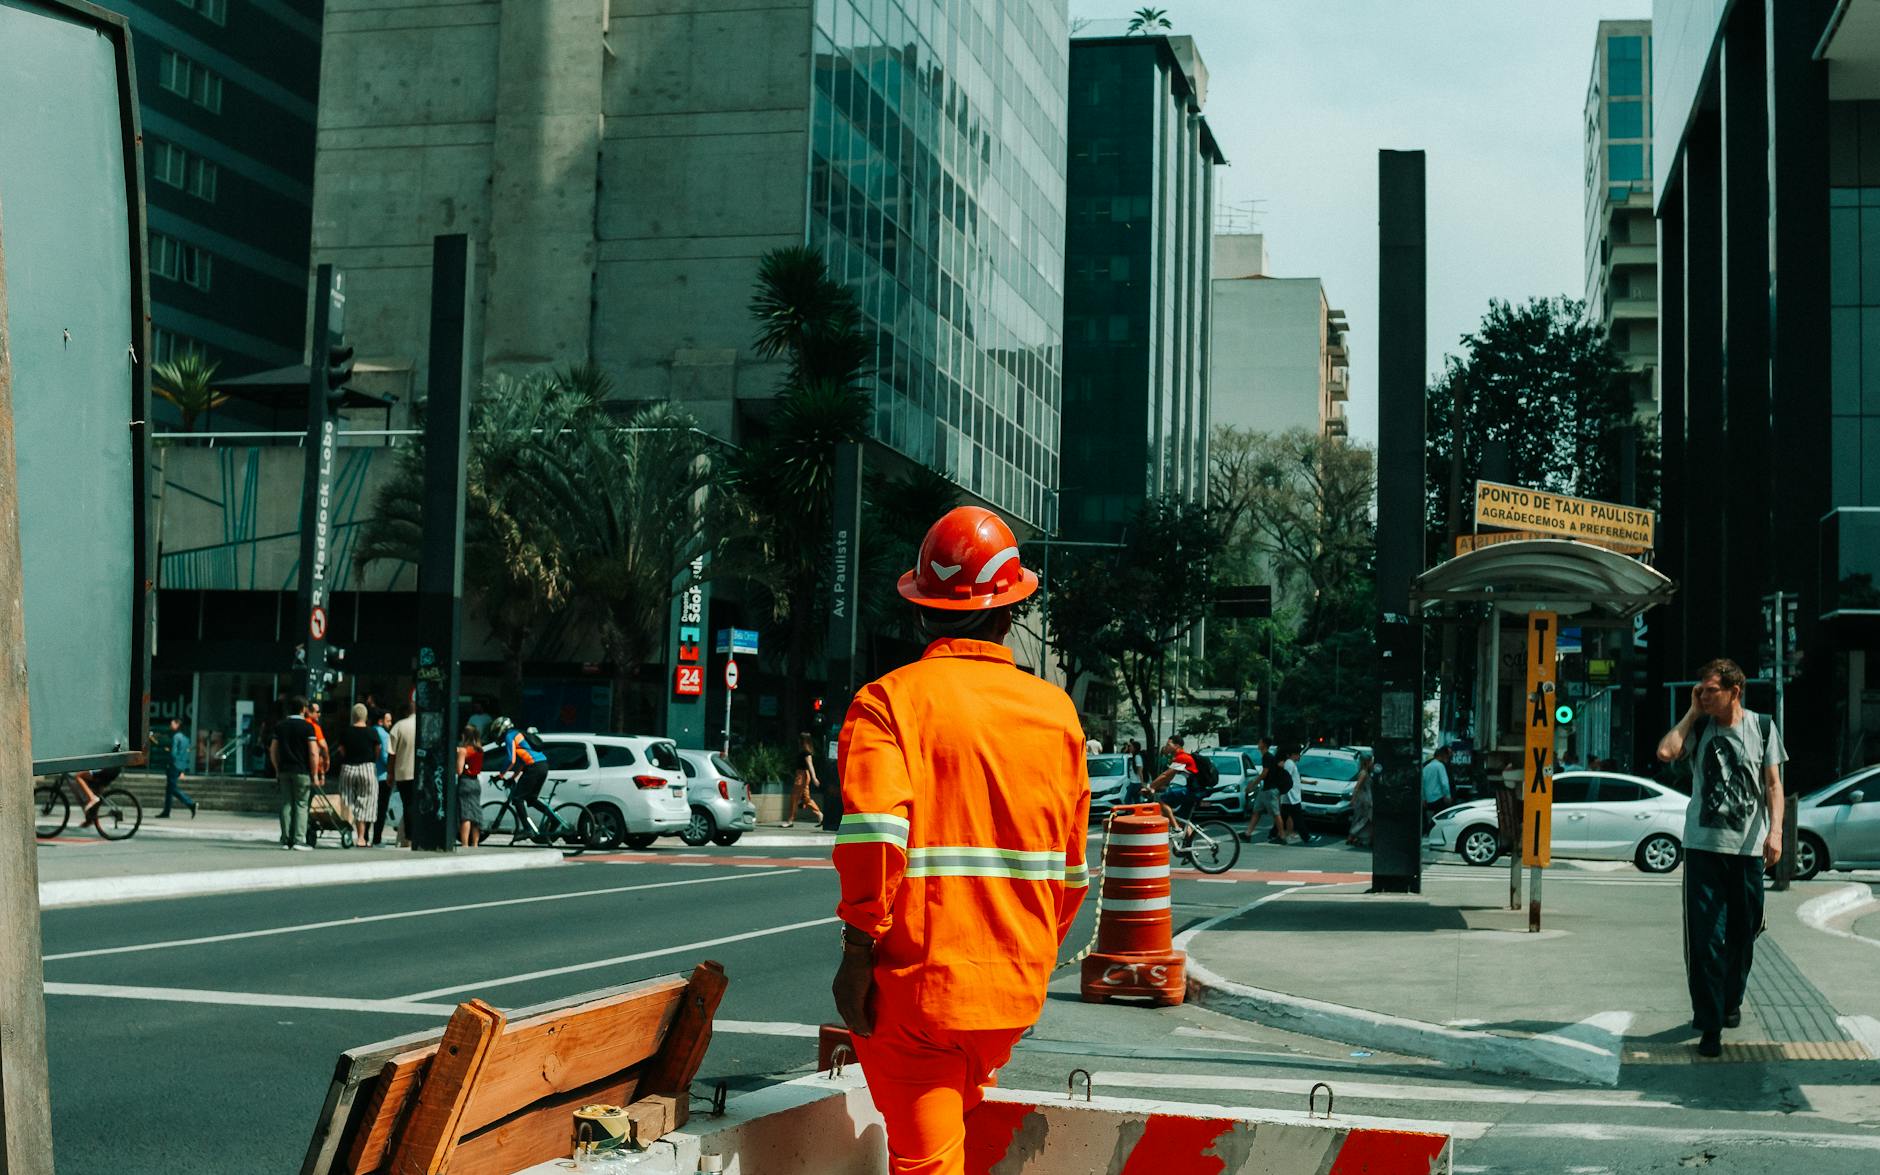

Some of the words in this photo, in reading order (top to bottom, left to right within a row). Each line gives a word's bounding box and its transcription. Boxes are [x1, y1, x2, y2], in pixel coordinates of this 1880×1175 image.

[321, 421, 333, 475] Lobo
[1481, 487, 1529, 507] PONTO
[1533, 495, 1551, 511] DE
[1555, 499, 1585, 517] TAXI
[1590, 505, 1650, 528] PAULISTA
[1482, 506, 1566, 530] AGRADECEMOS
[1569, 521, 1577, 532] A
[314, 483, 330, 580] Haddock
[834, 530, 848, 593] Paulista
[313, 586, 323, 605] R.
[833, 597, 845, 618] Av.
[680, 668, 701, 685] 24
[1531, 618, 1549, 857] TAXI
